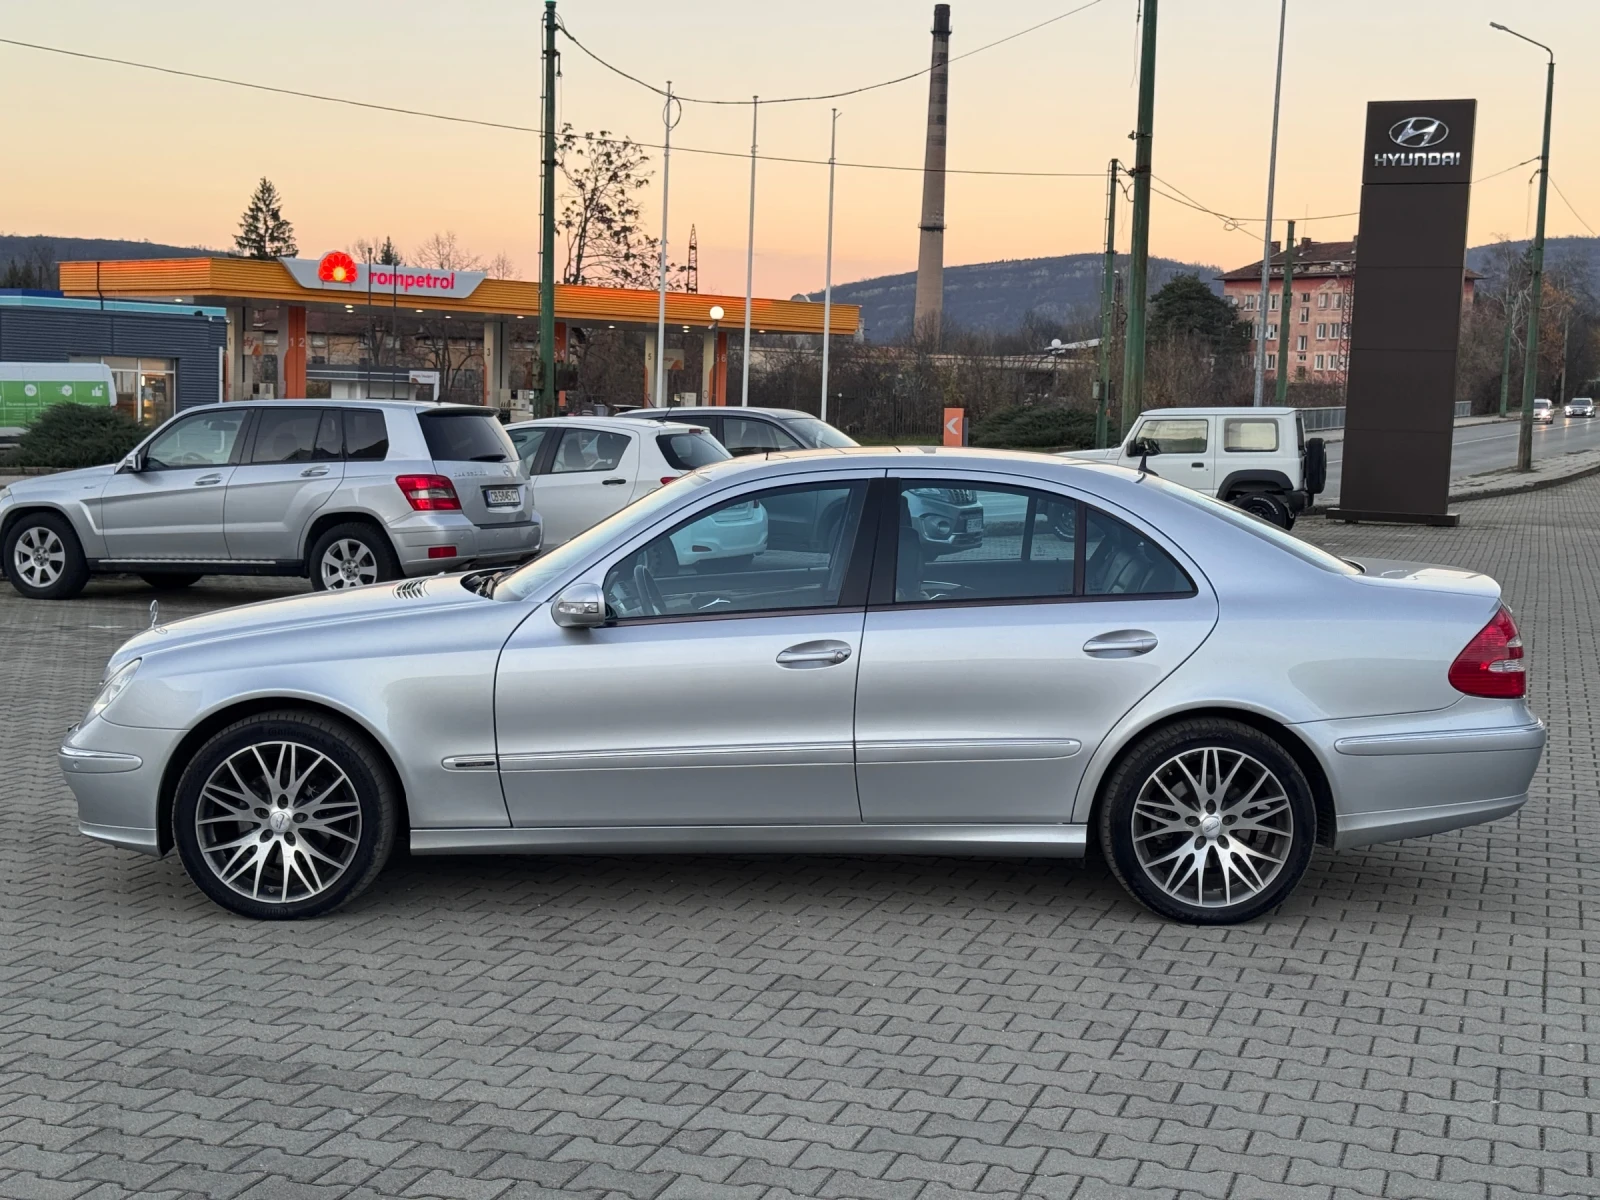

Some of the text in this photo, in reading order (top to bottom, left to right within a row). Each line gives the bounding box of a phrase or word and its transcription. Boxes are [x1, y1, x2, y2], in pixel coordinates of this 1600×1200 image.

[1374, 152, 1461, 167] HYUNDAI
[370, 271, 455, 292] rompetrol
[290, 338, 305, 347] 1 2
[487, 348, 491, 356] 3
[559, 349, 565, 358] 4
[721, 354, 727, 362] 6
